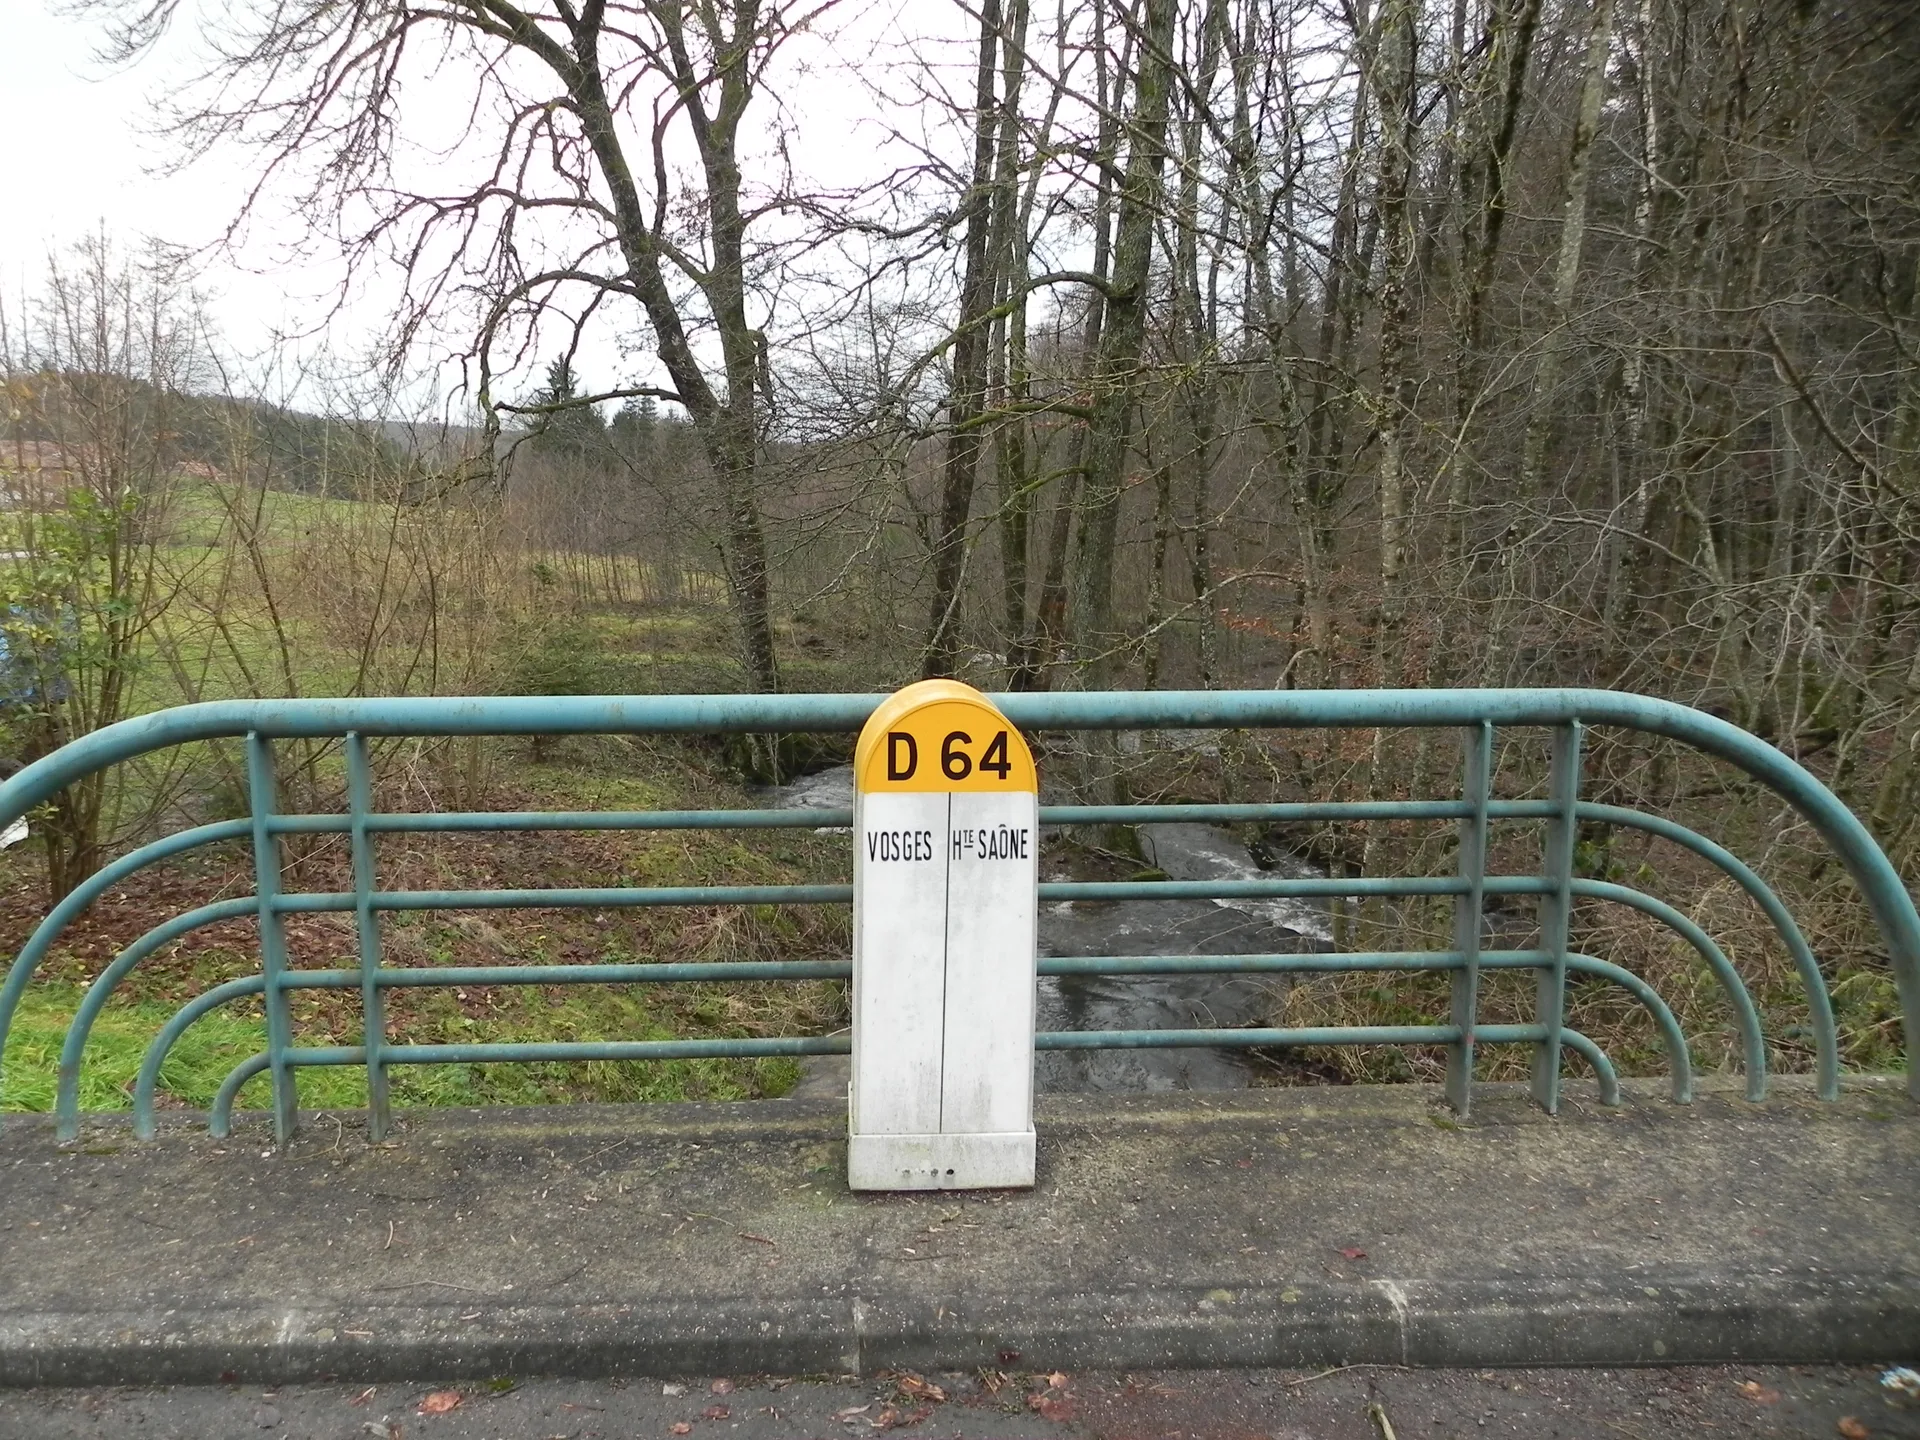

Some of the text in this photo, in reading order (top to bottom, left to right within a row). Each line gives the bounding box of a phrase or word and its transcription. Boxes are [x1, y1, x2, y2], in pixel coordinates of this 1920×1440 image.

[888, 731, 1012, 781] D 64
[868, 831, 932, 862] VOSGES
[978, 823, 1029, 860] SAÔNE
